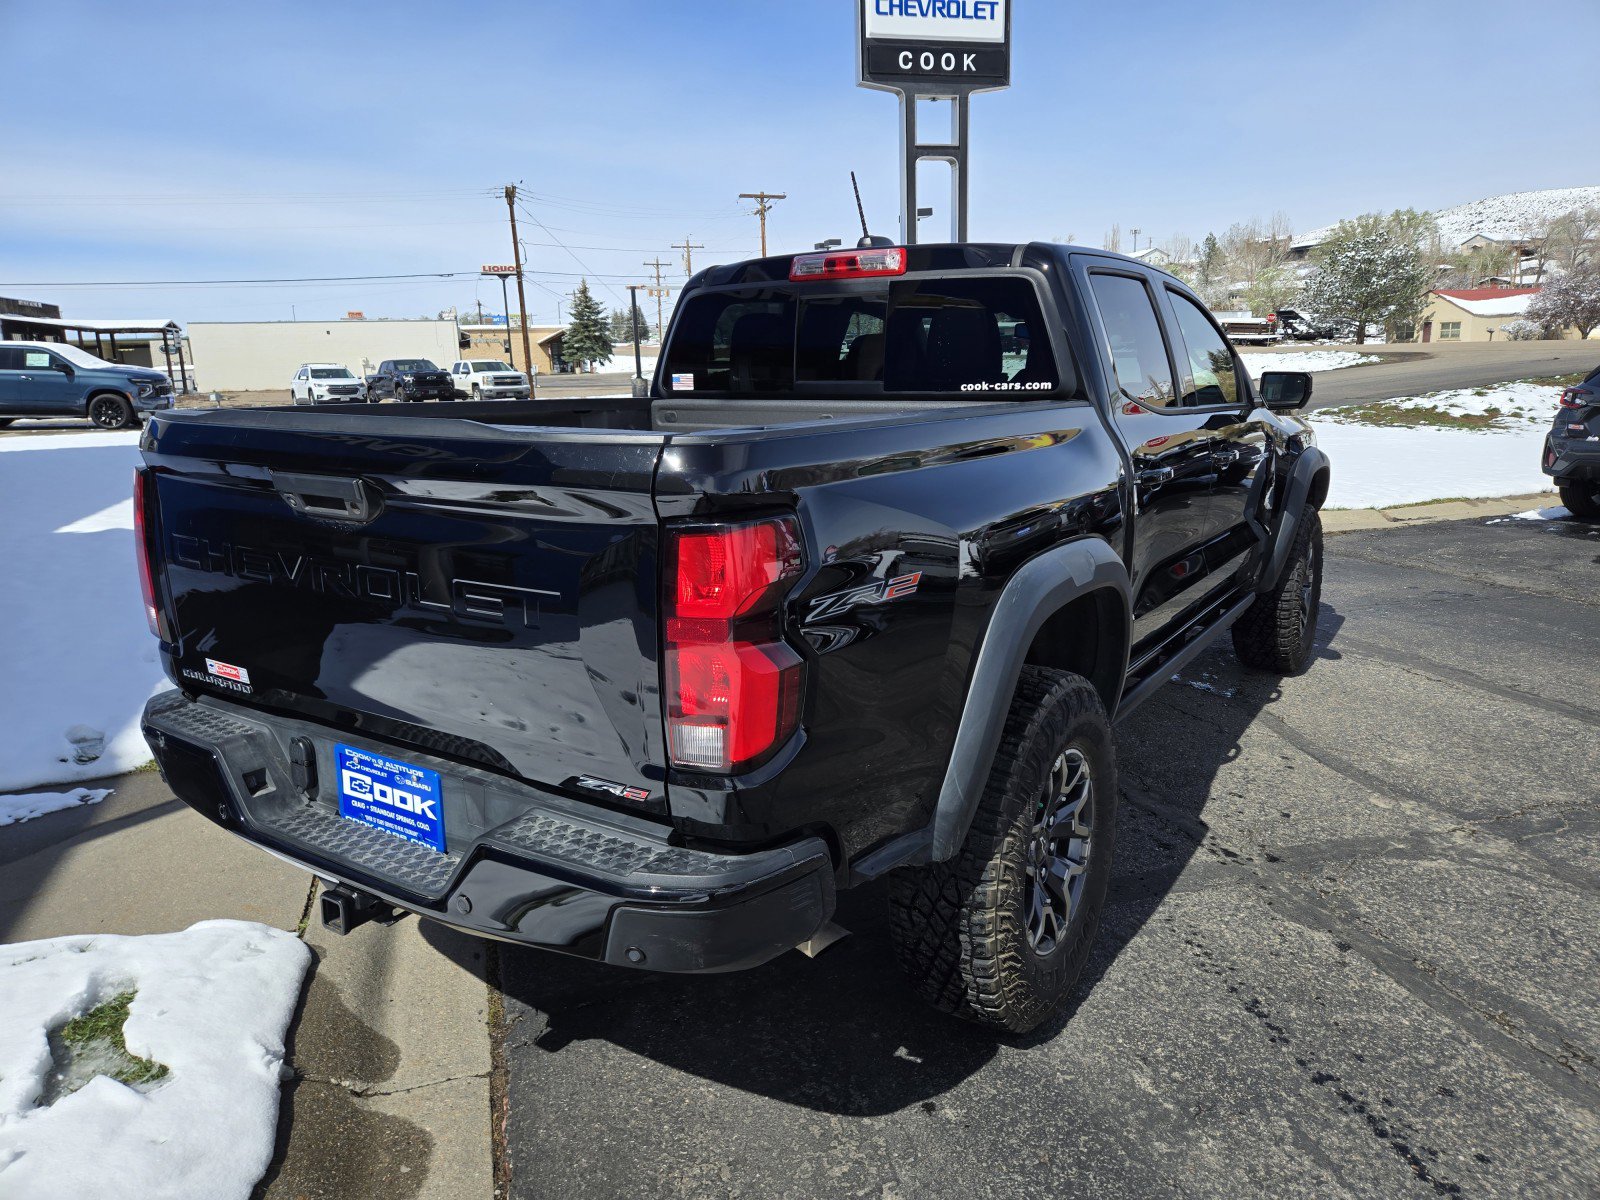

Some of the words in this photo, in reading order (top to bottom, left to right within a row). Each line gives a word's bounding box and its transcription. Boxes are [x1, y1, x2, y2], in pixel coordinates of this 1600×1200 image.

[875, 0, 998, 20] CHEVROLET
[898, 50, 977, 72] COOK
[960, 381, 1052, 391] cook-cars.com
[171, 531, 562, 630] CHEVROLET
[804, 570, 922, 624] ZR2
[342, 769, 437, 821] COOK
